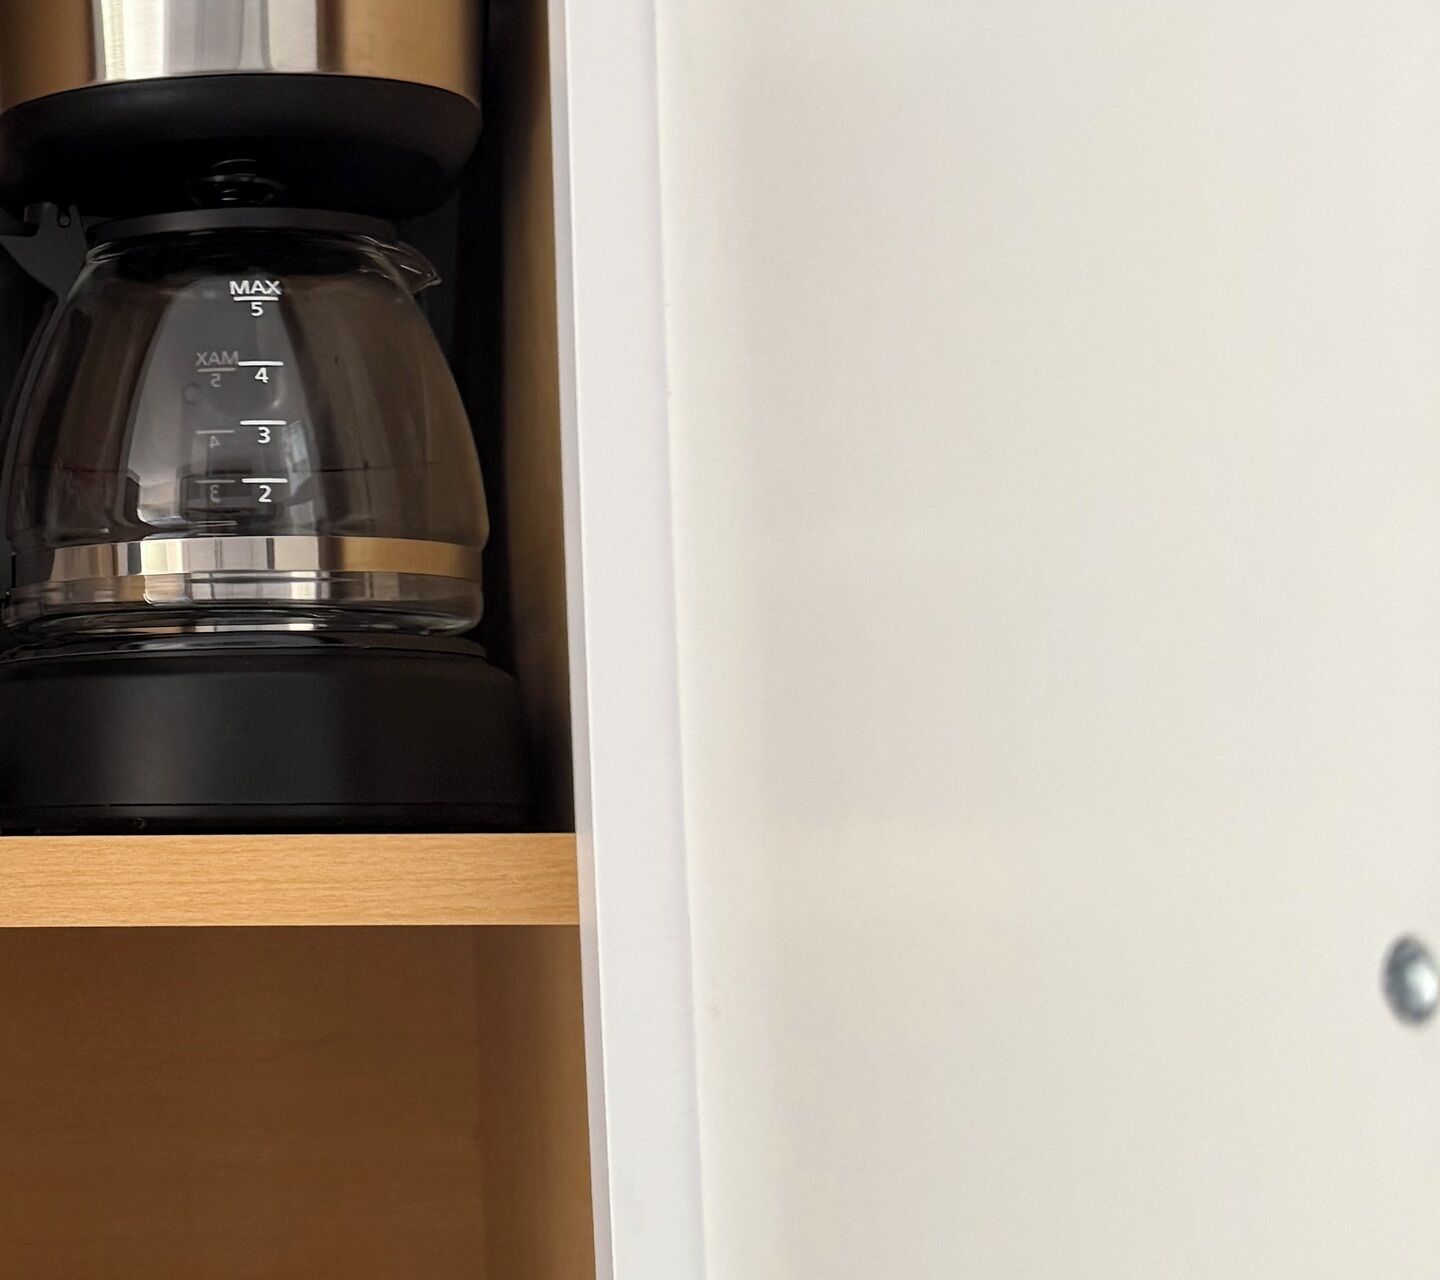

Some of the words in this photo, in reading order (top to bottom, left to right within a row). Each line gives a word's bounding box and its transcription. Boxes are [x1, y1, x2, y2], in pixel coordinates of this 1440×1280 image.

[229, 280, 281, 295] MAX
[250, 301, 264, 317] 5
[254, 367, 269, 383] 4
[257, 426, 271, 444] 3
[258, 485, 272, 502] 2
